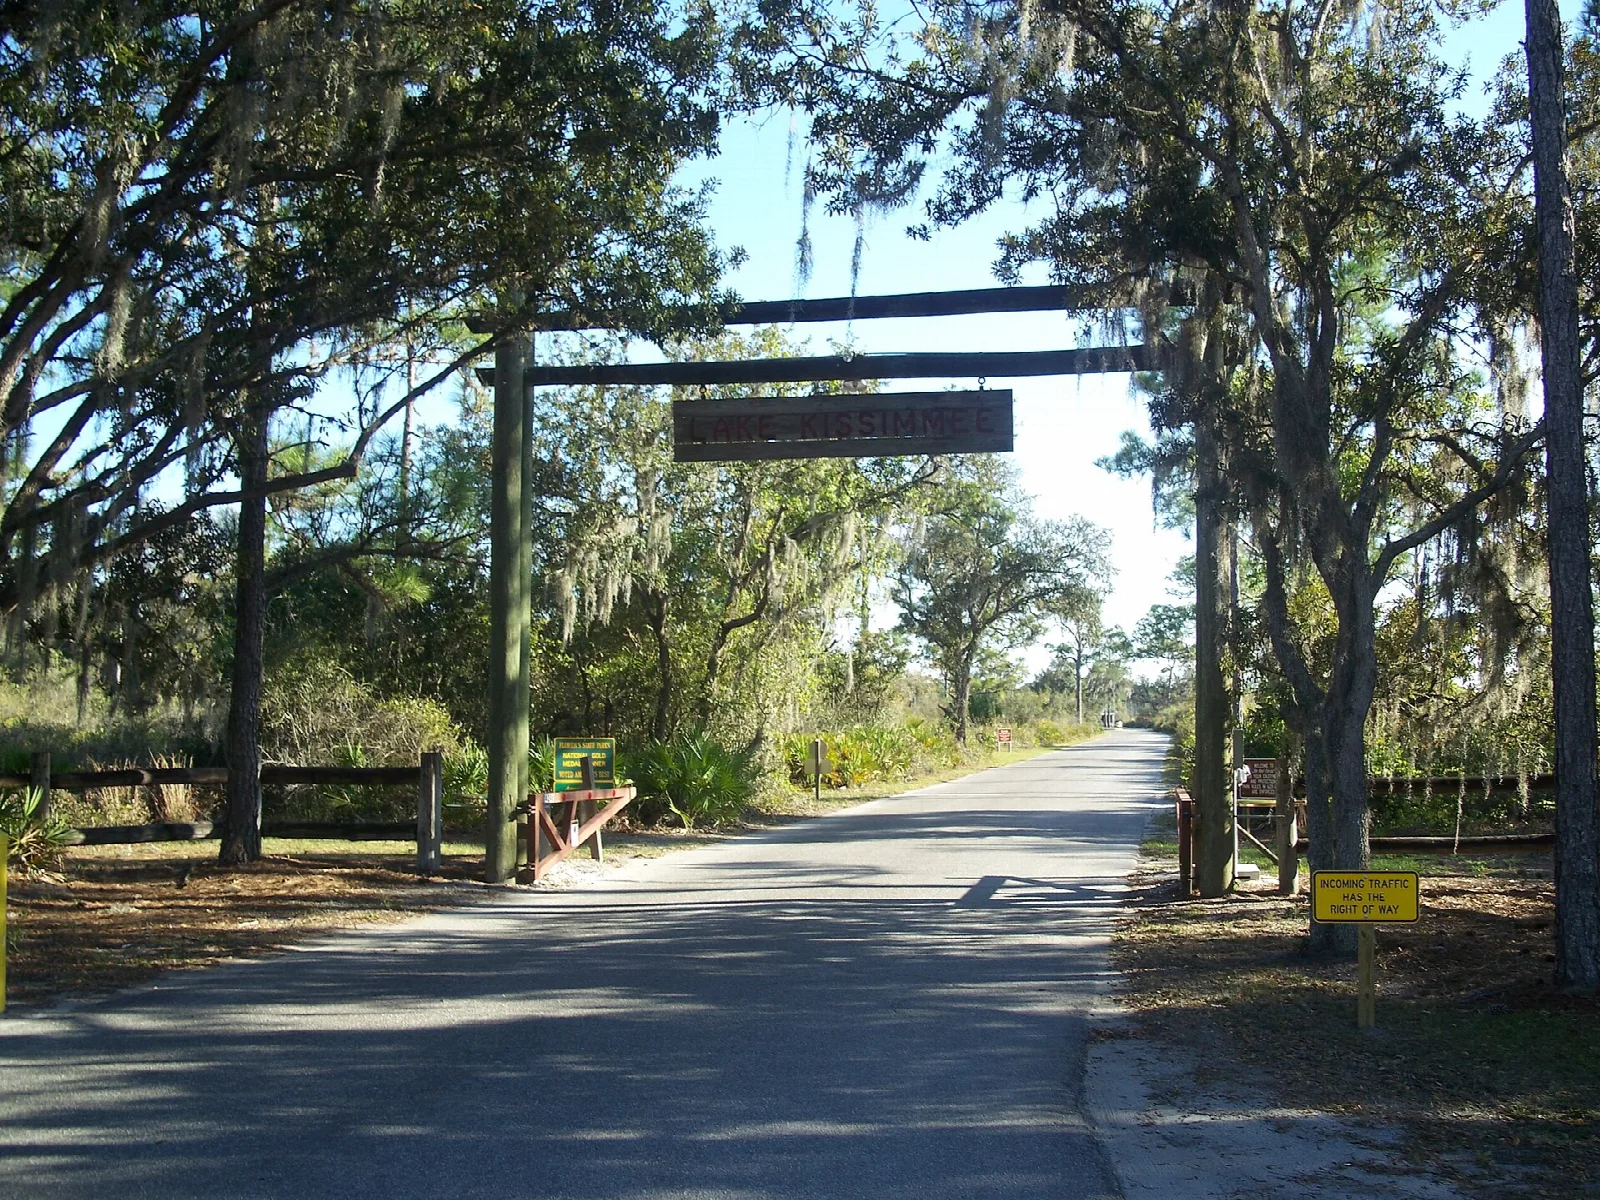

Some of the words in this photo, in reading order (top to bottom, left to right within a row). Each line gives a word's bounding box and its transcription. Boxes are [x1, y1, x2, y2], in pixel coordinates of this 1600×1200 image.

[690, 415, 777, 443] LAKE
[800, 407, 995, 439] KISSIMMEE
[1320, 879, 1365, 889] INCOMING
[1368, 879, 1409, 889] TRAFFIC
[1342, 892, 1363, 902] HAS
[1367, 892, 1385, 902] THE
[1330, 904, 1358, 914] RIGHT
[1362, 904, 1375, 914] OF
[1378, 904, 1399, 914] WAY
